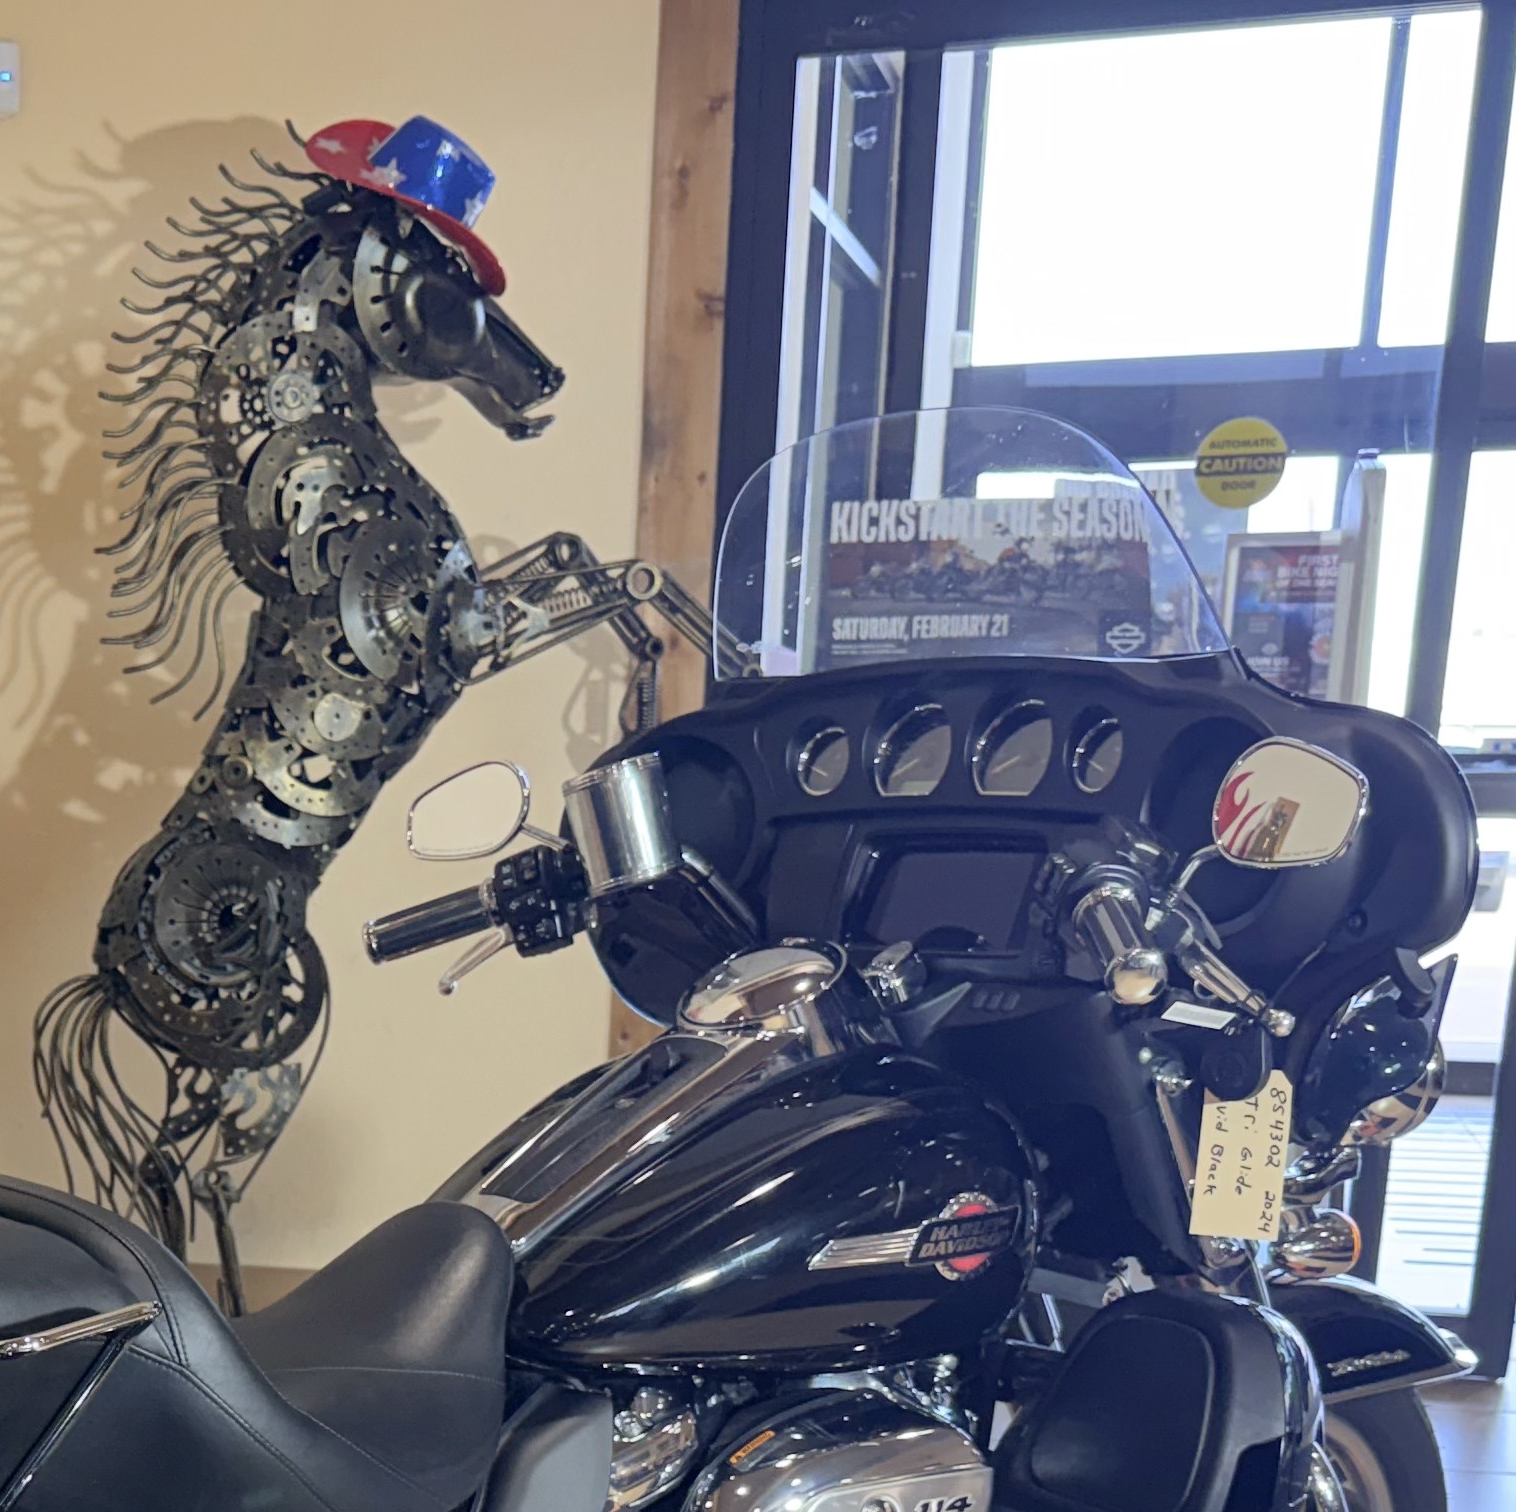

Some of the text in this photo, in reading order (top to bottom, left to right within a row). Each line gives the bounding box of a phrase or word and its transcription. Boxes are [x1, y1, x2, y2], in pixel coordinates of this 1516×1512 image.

[1209, 437, 1278, 450] AUTOMATIC
[1199, 456, 1284, 475] CAUTION
[1220, 480, 1256, 491] DOOR
[829, 499, 984, 545] KICKSTART
[1051, 497, 1151, 542] SEASON
[1299, 554, 1339, 567] FIRST
[831, 615, 909, 642] SATURDAY,
[911, 614, 991, 640] FEBRUARY
[1202, 1143, 1225, 1196] Black
[1234, 1147, 1253, 1196] Glide
[1257, 1087, 1288, 1234] 854302 2024
[917, 1231, 1012, 1258] DAVIDSON
